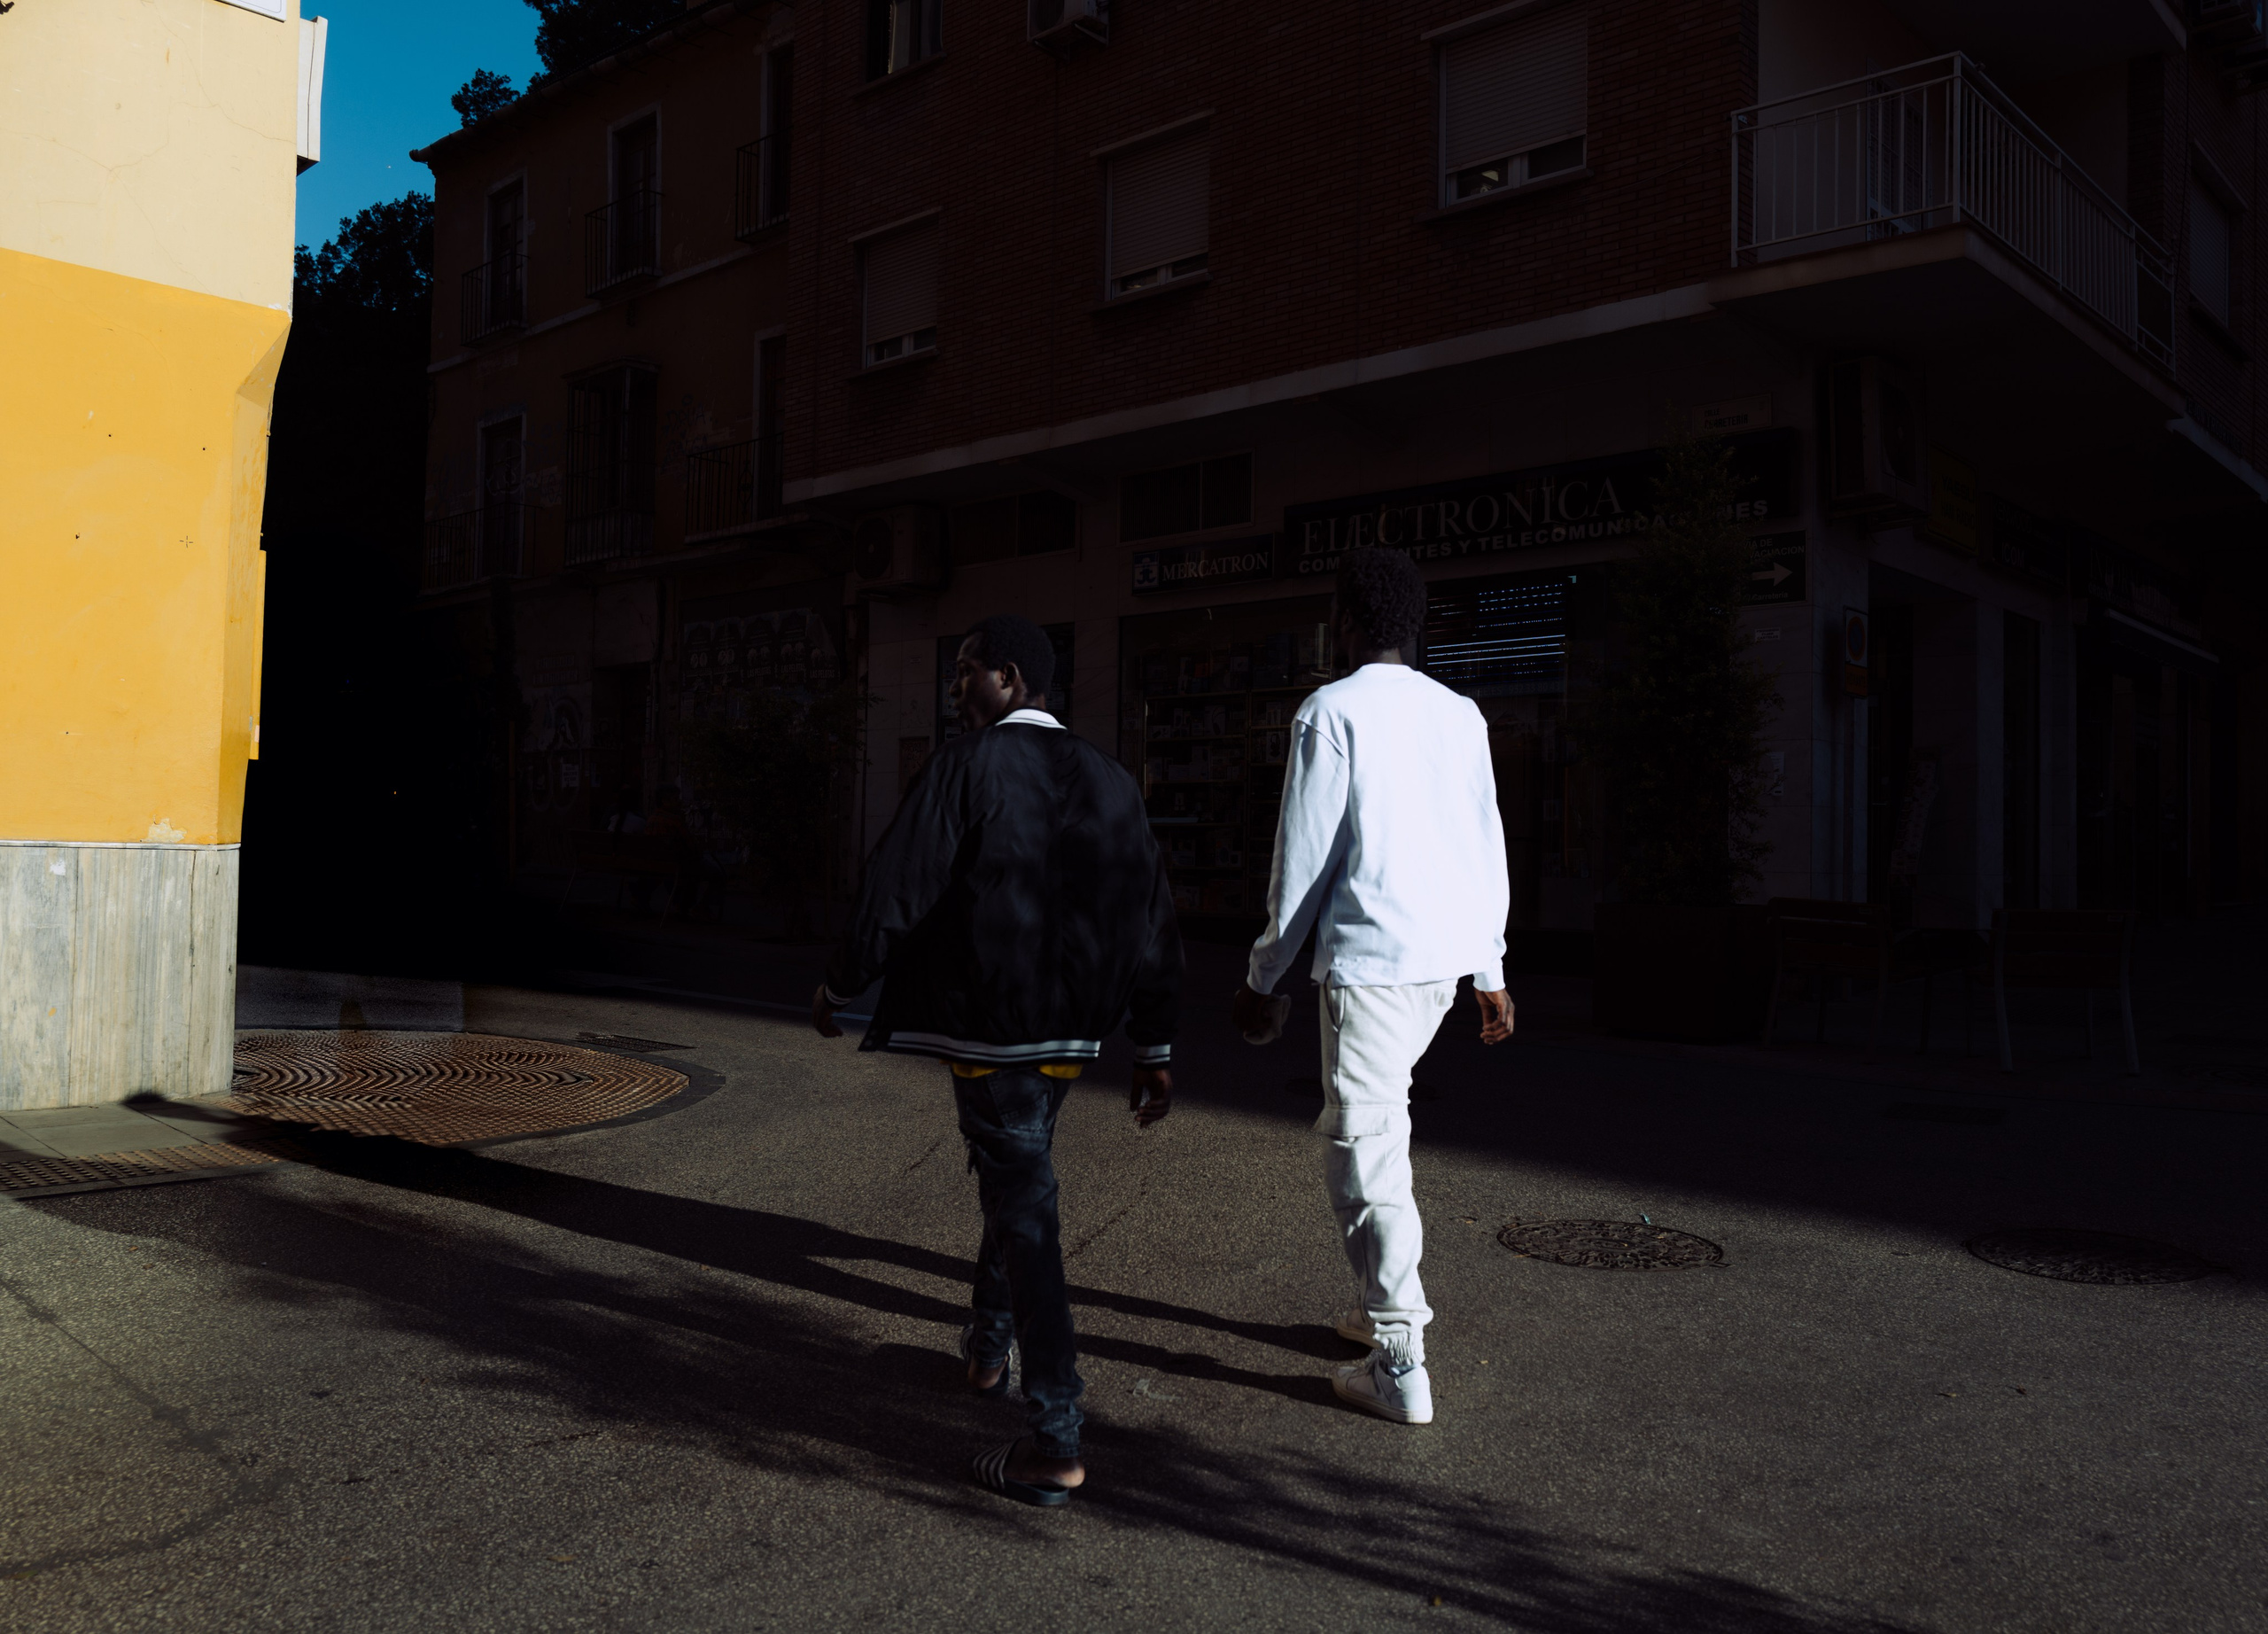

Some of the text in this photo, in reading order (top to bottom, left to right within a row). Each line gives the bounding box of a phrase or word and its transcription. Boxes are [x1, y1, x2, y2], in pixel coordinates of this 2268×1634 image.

[1301, 476, 1626, 556] ELECTRONICA
[1459, 539, 1473, 555] Y
[1747, 545, 1805, 560] VACUACION
[1759, 537, 1773, 548] DE
[2001, 541, 2025, 568] ICOM
[1161, 551, 1270, 581] MERCATRON
